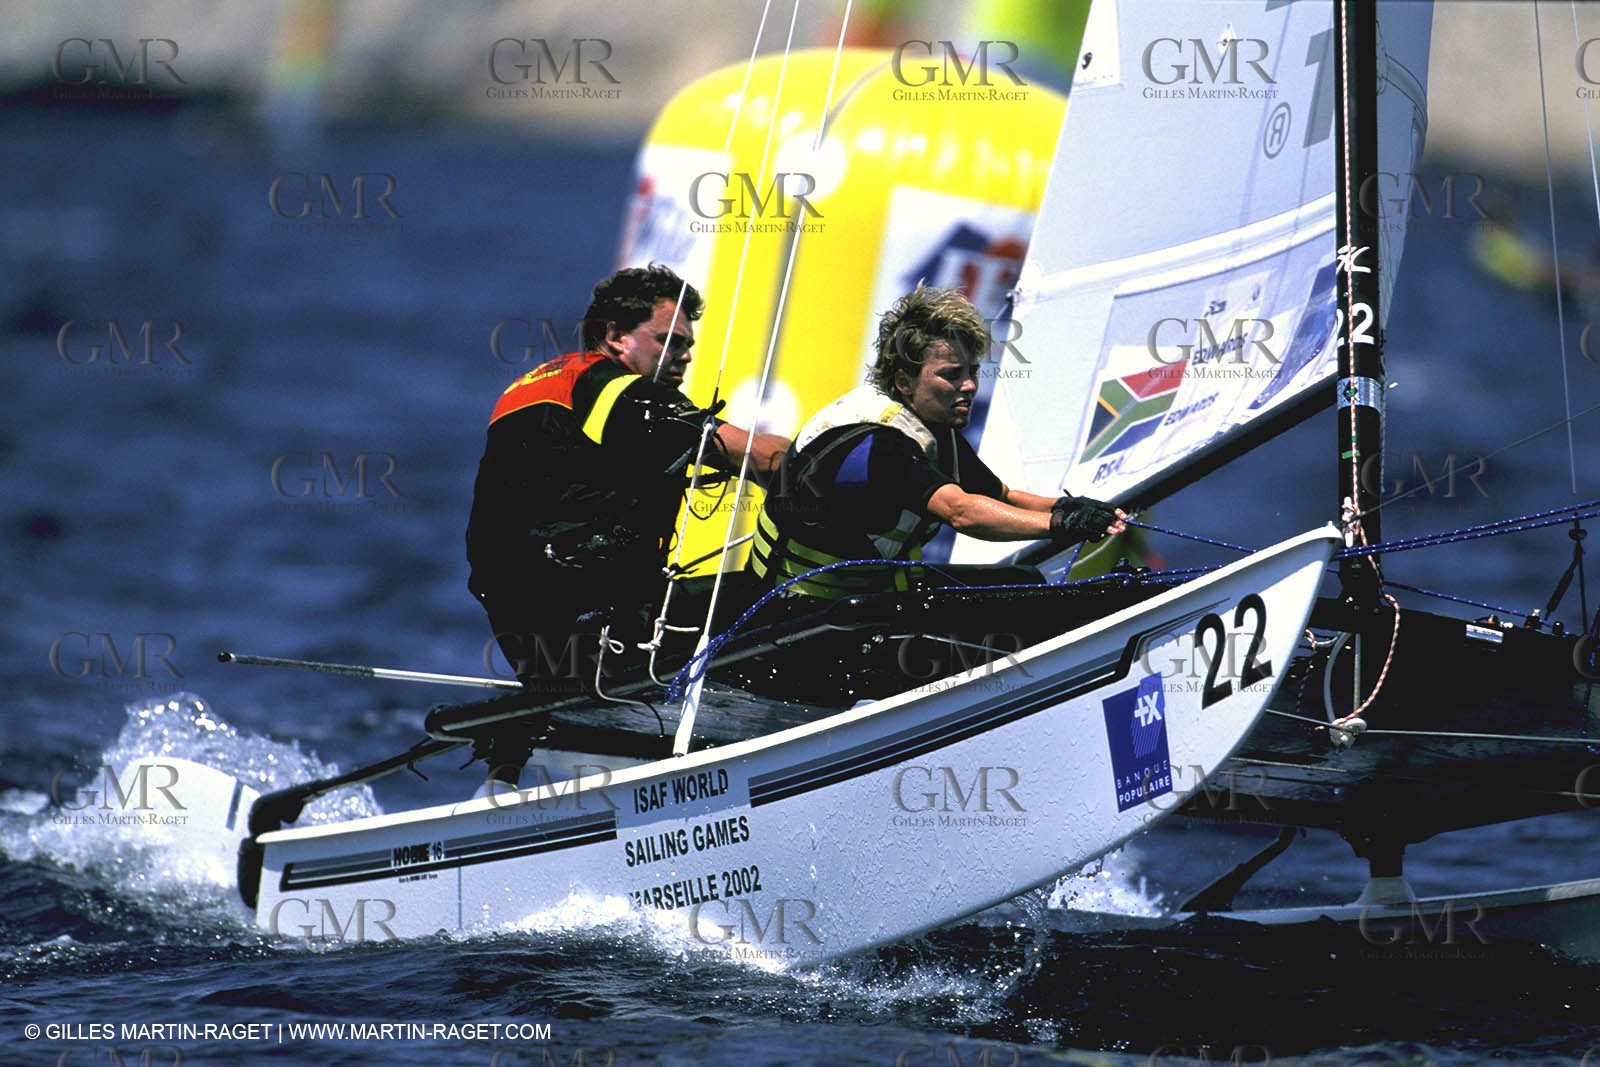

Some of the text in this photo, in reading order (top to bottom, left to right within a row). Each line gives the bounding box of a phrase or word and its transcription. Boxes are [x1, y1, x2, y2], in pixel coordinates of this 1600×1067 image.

[1194, 592, 1273, 711] 22
[633, 768, 729, 814] ISAF WORLD
[1116, 760, 1168, 789] BANQUE
[1119, 775, 1171, 806] POPULAIRE
[625, 815, 750, 868] SAILING GAMES
[721, 864, 763, 898] 2002
